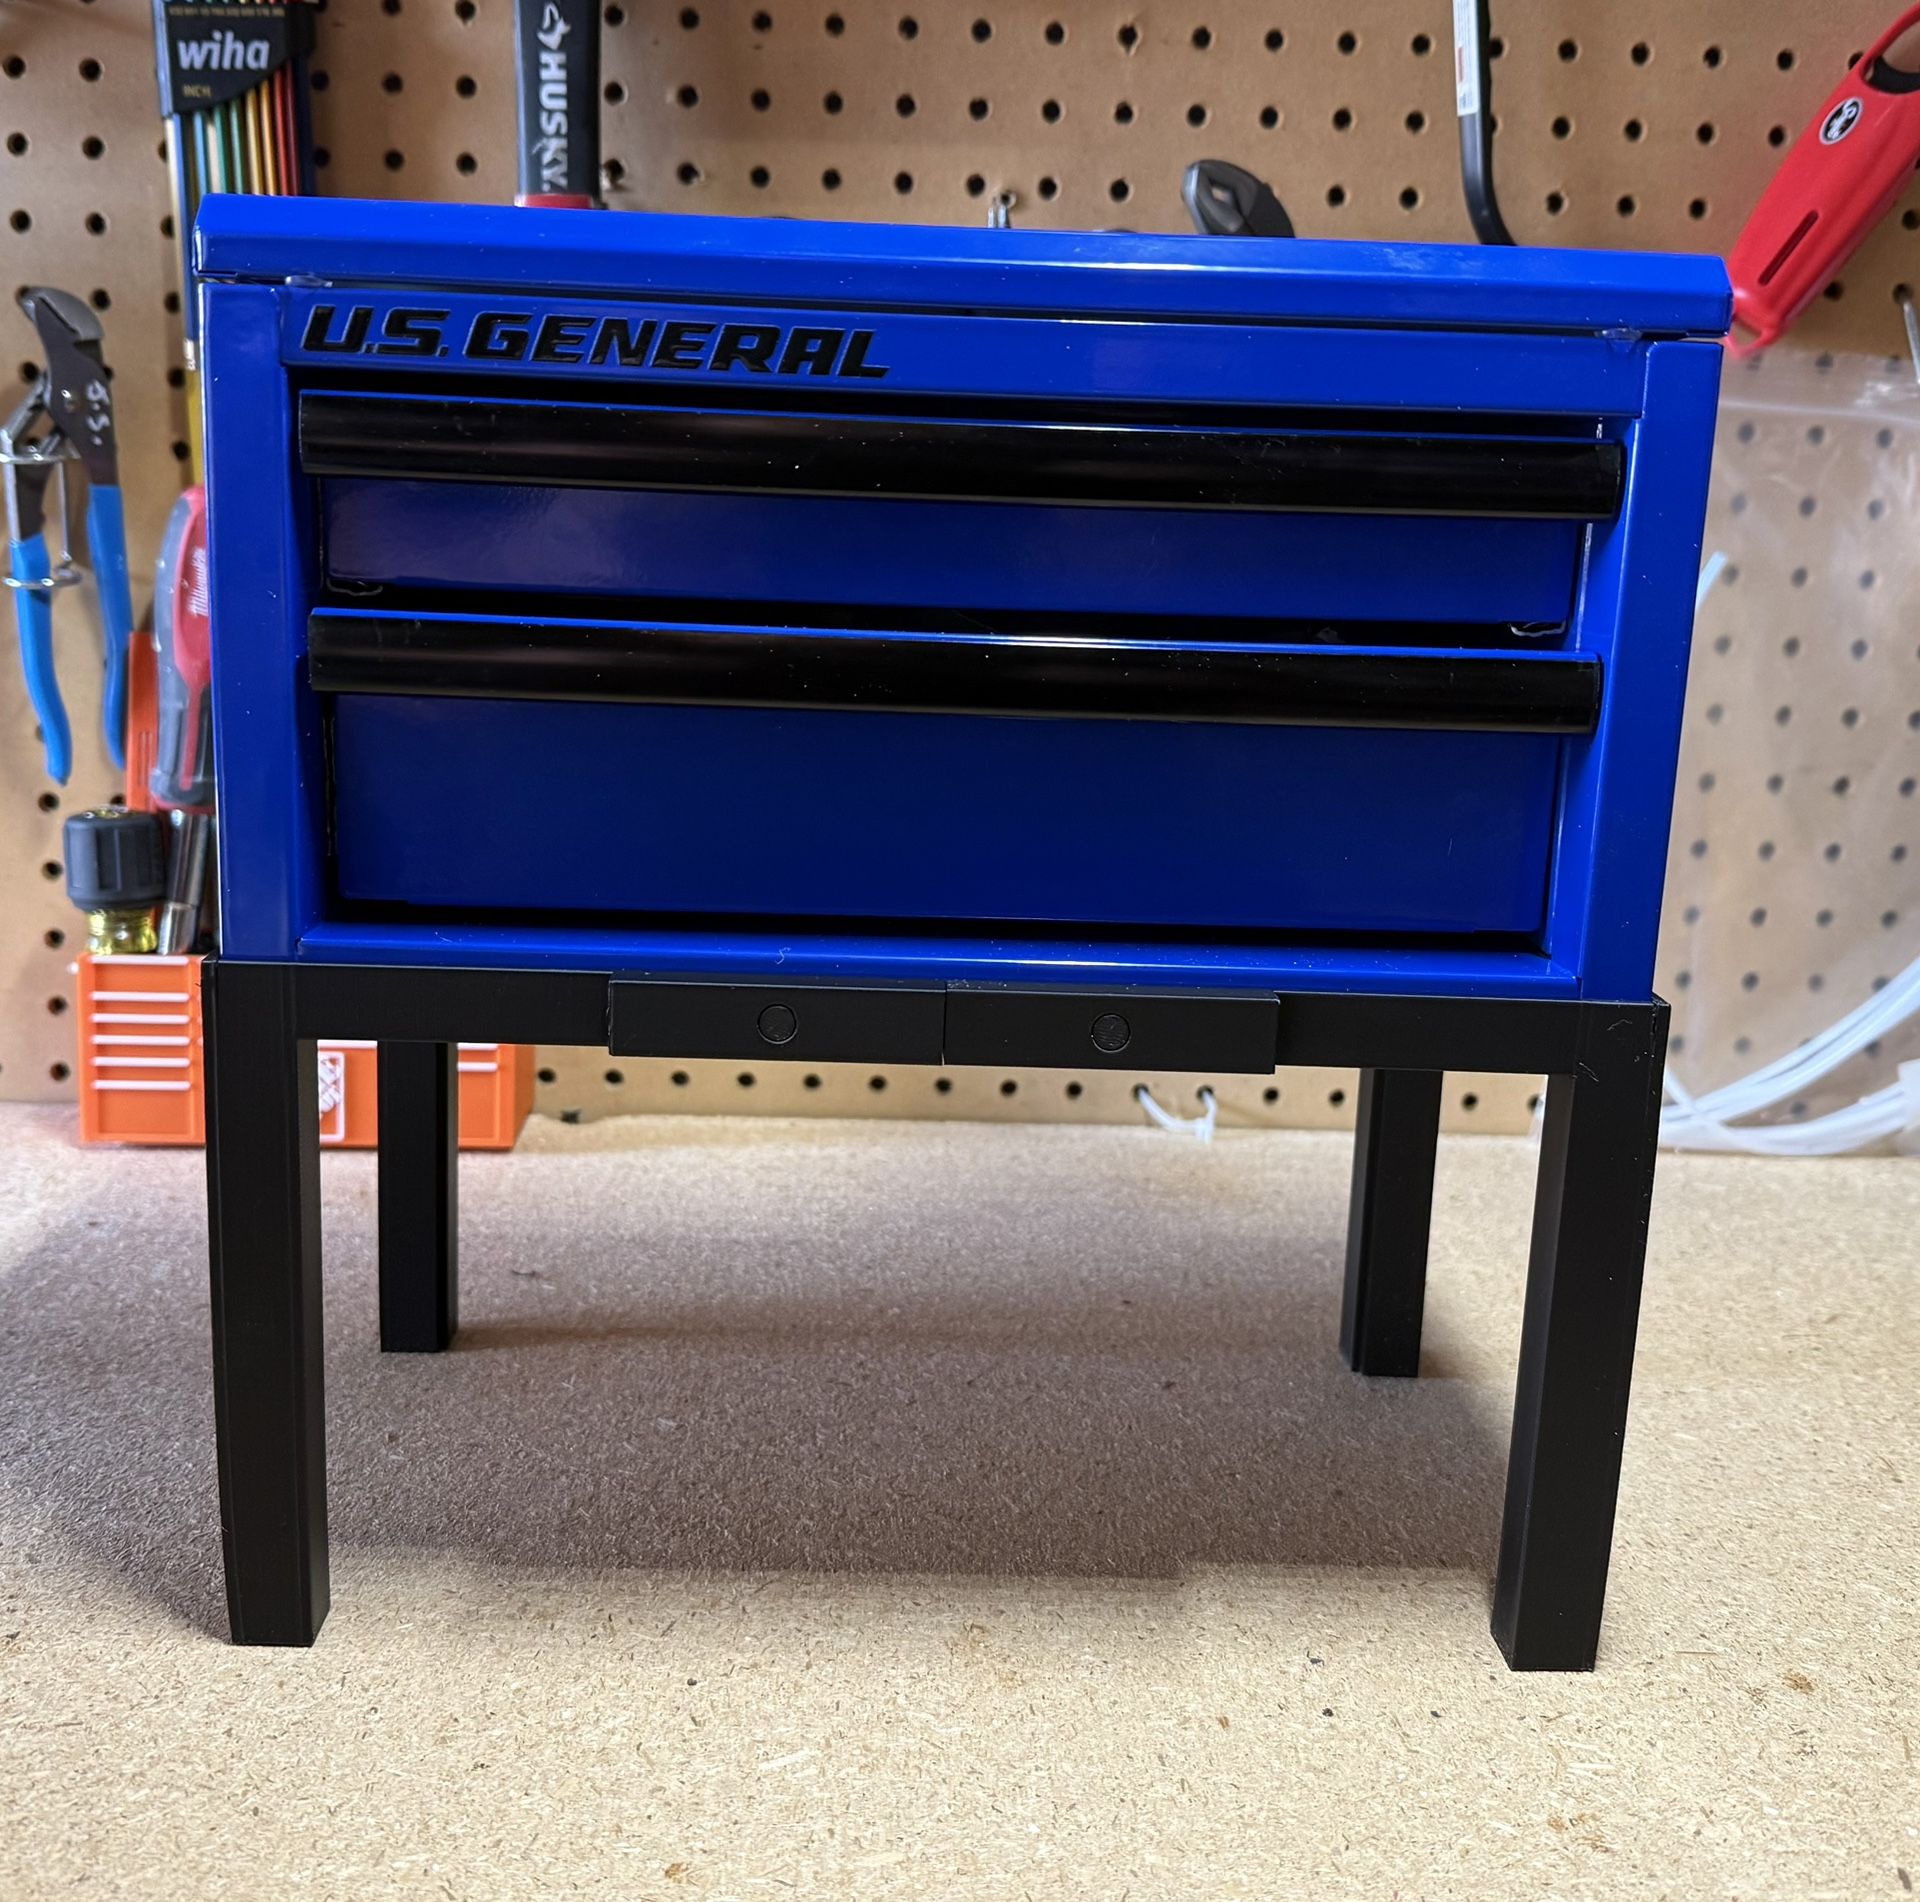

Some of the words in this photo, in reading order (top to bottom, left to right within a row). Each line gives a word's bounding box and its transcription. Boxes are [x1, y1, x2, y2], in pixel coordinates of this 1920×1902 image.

[177, 29, 270, 71] wiha
[182, 84, 212, 98] INCH
[301, 305, 451, 357] U.S.
[462, 310, 892, 379] GENERAL
